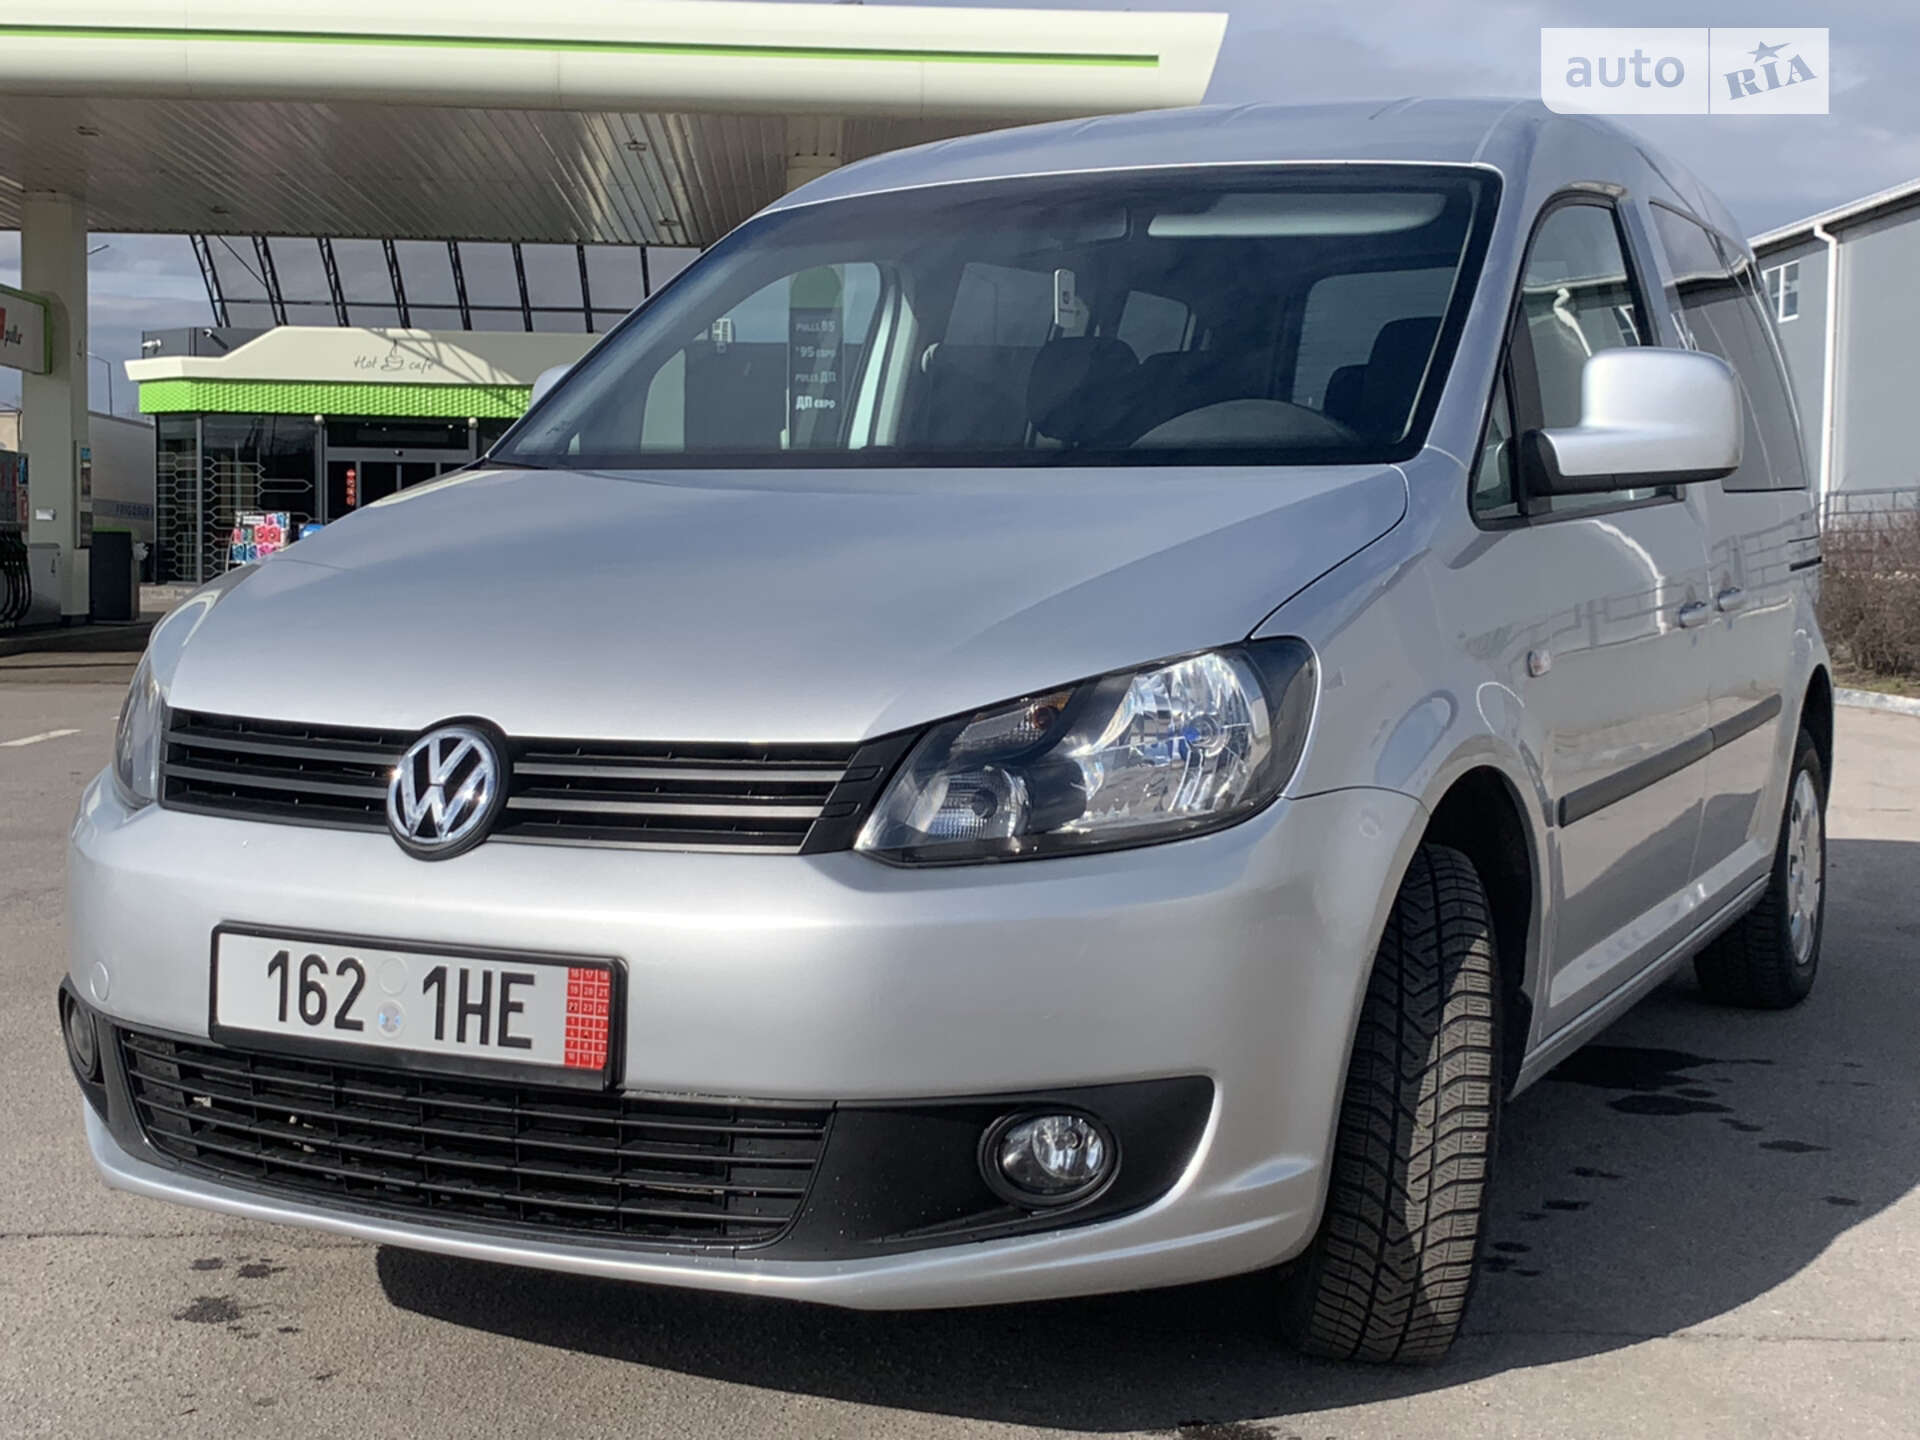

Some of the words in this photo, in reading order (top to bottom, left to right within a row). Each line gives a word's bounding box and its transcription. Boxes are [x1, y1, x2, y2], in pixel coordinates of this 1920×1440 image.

[353, 355, 377, 369] Hot
[267, 950, 366, 1032] 162
[423, 965, 535, 1050] 1HE
